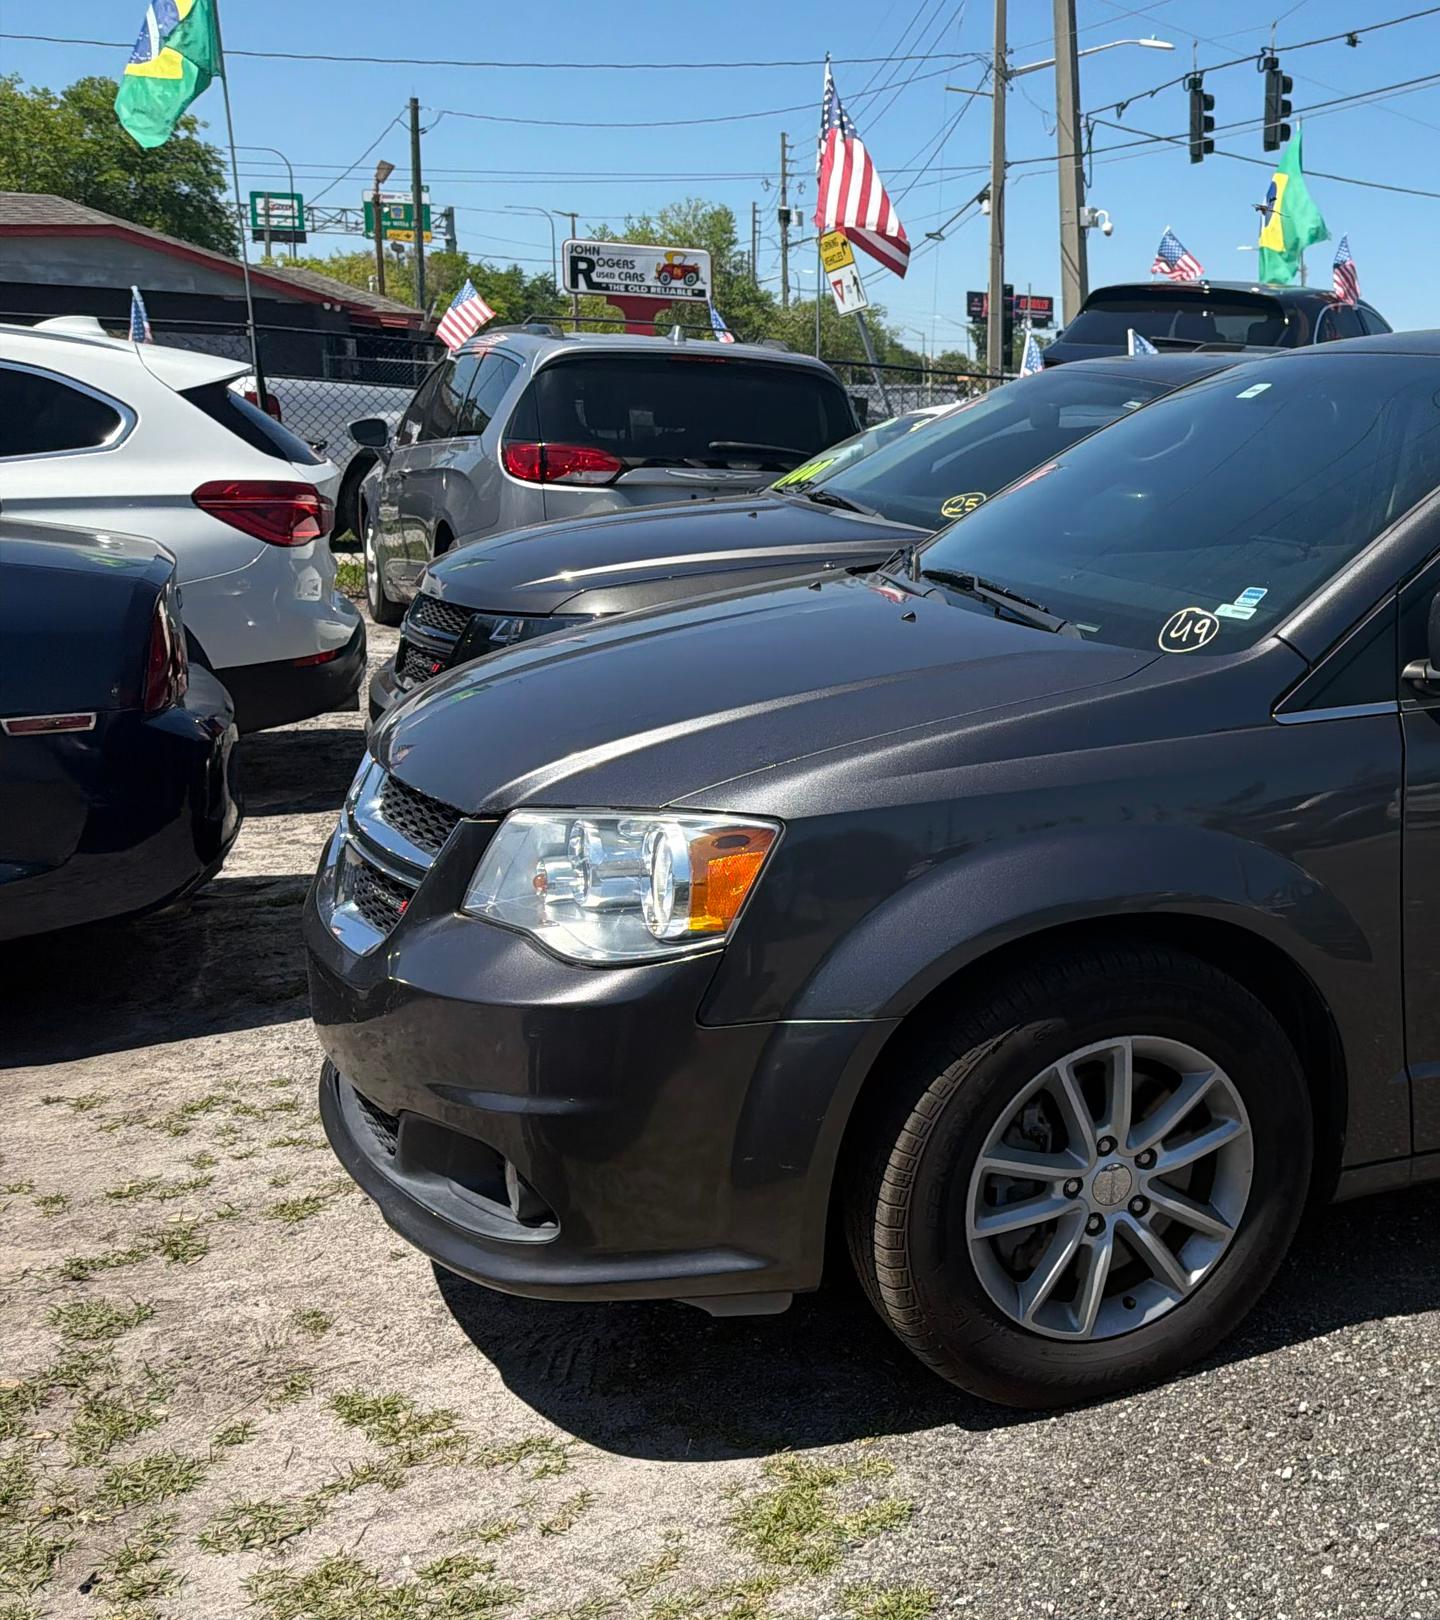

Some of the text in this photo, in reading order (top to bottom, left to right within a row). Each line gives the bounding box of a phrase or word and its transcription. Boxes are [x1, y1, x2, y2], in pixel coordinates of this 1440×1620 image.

[569, 245, 600, 256] JOHN
[596, 271, 645, 283] USED CARS
[628, 285, 648, 293] OLD
[944, 496, 979, 514] 25
[1169, 611, 1212, 644] 49
